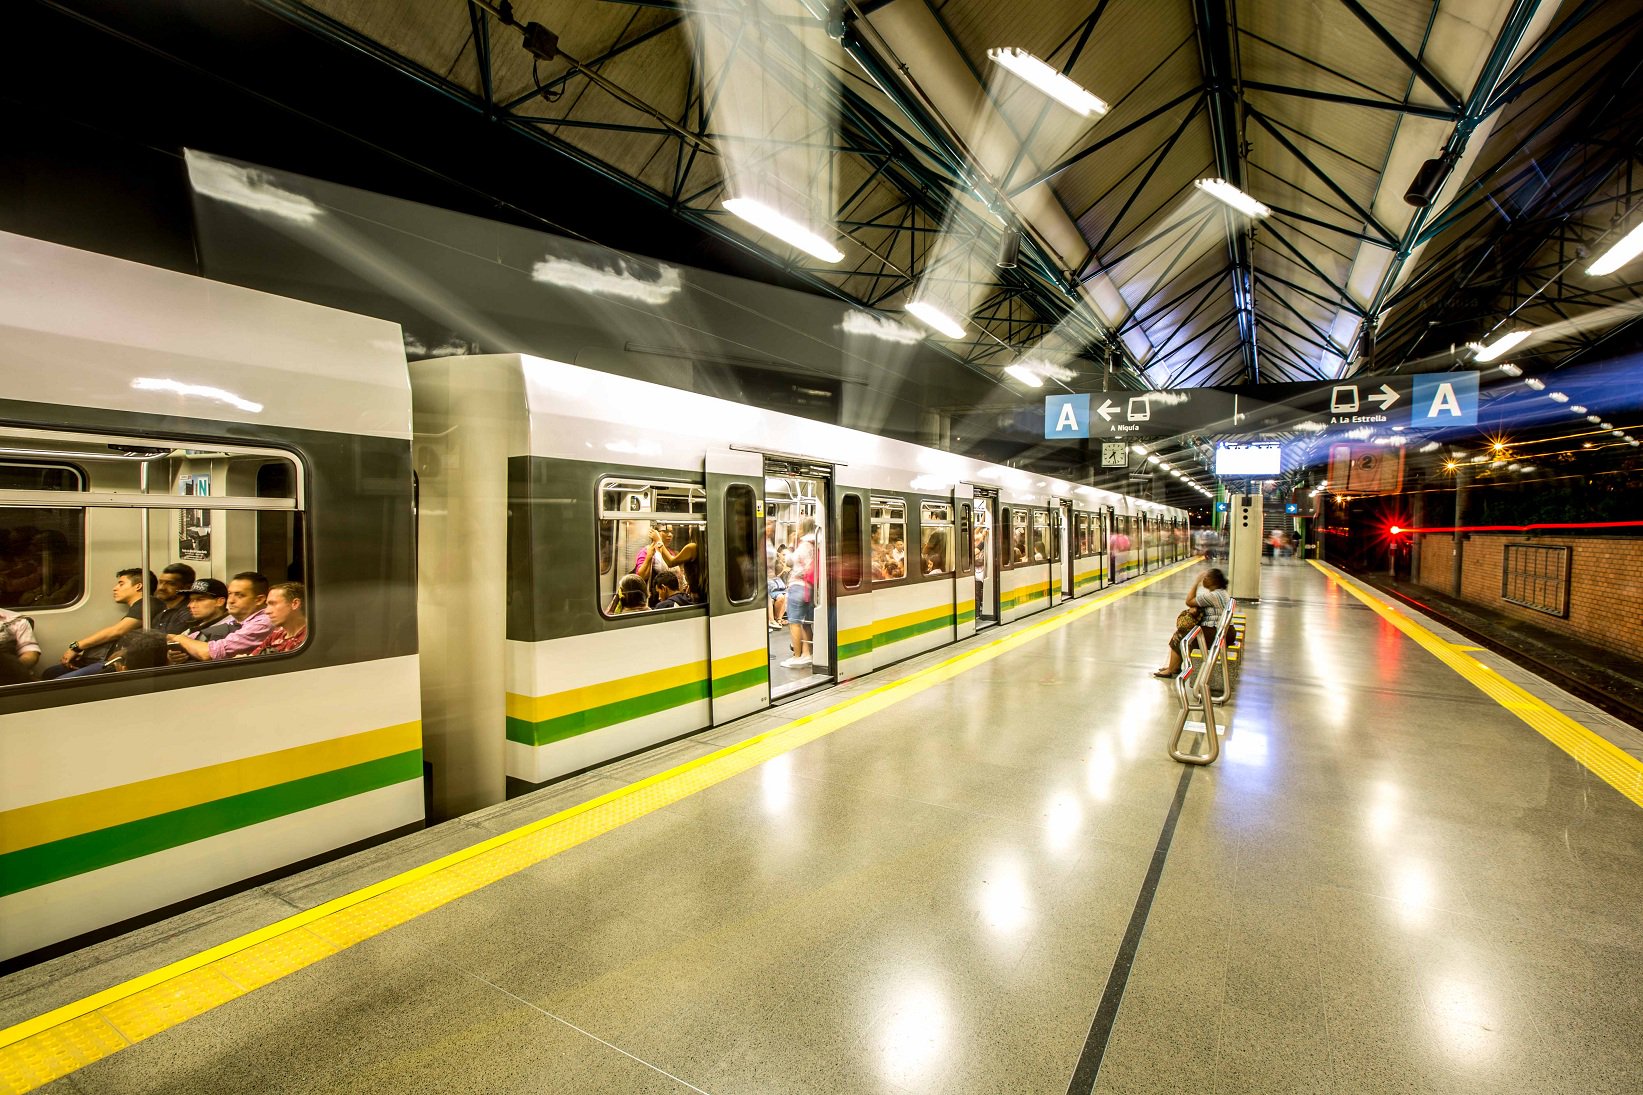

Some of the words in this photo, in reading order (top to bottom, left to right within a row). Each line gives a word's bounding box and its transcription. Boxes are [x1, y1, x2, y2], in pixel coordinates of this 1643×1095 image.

[1427, 383, 1462, 417] A
[1056, 403, 1079, 431] A
[1117, 424, 1139, 432] Niquía
[1362, 456, 1372, 468] 2
